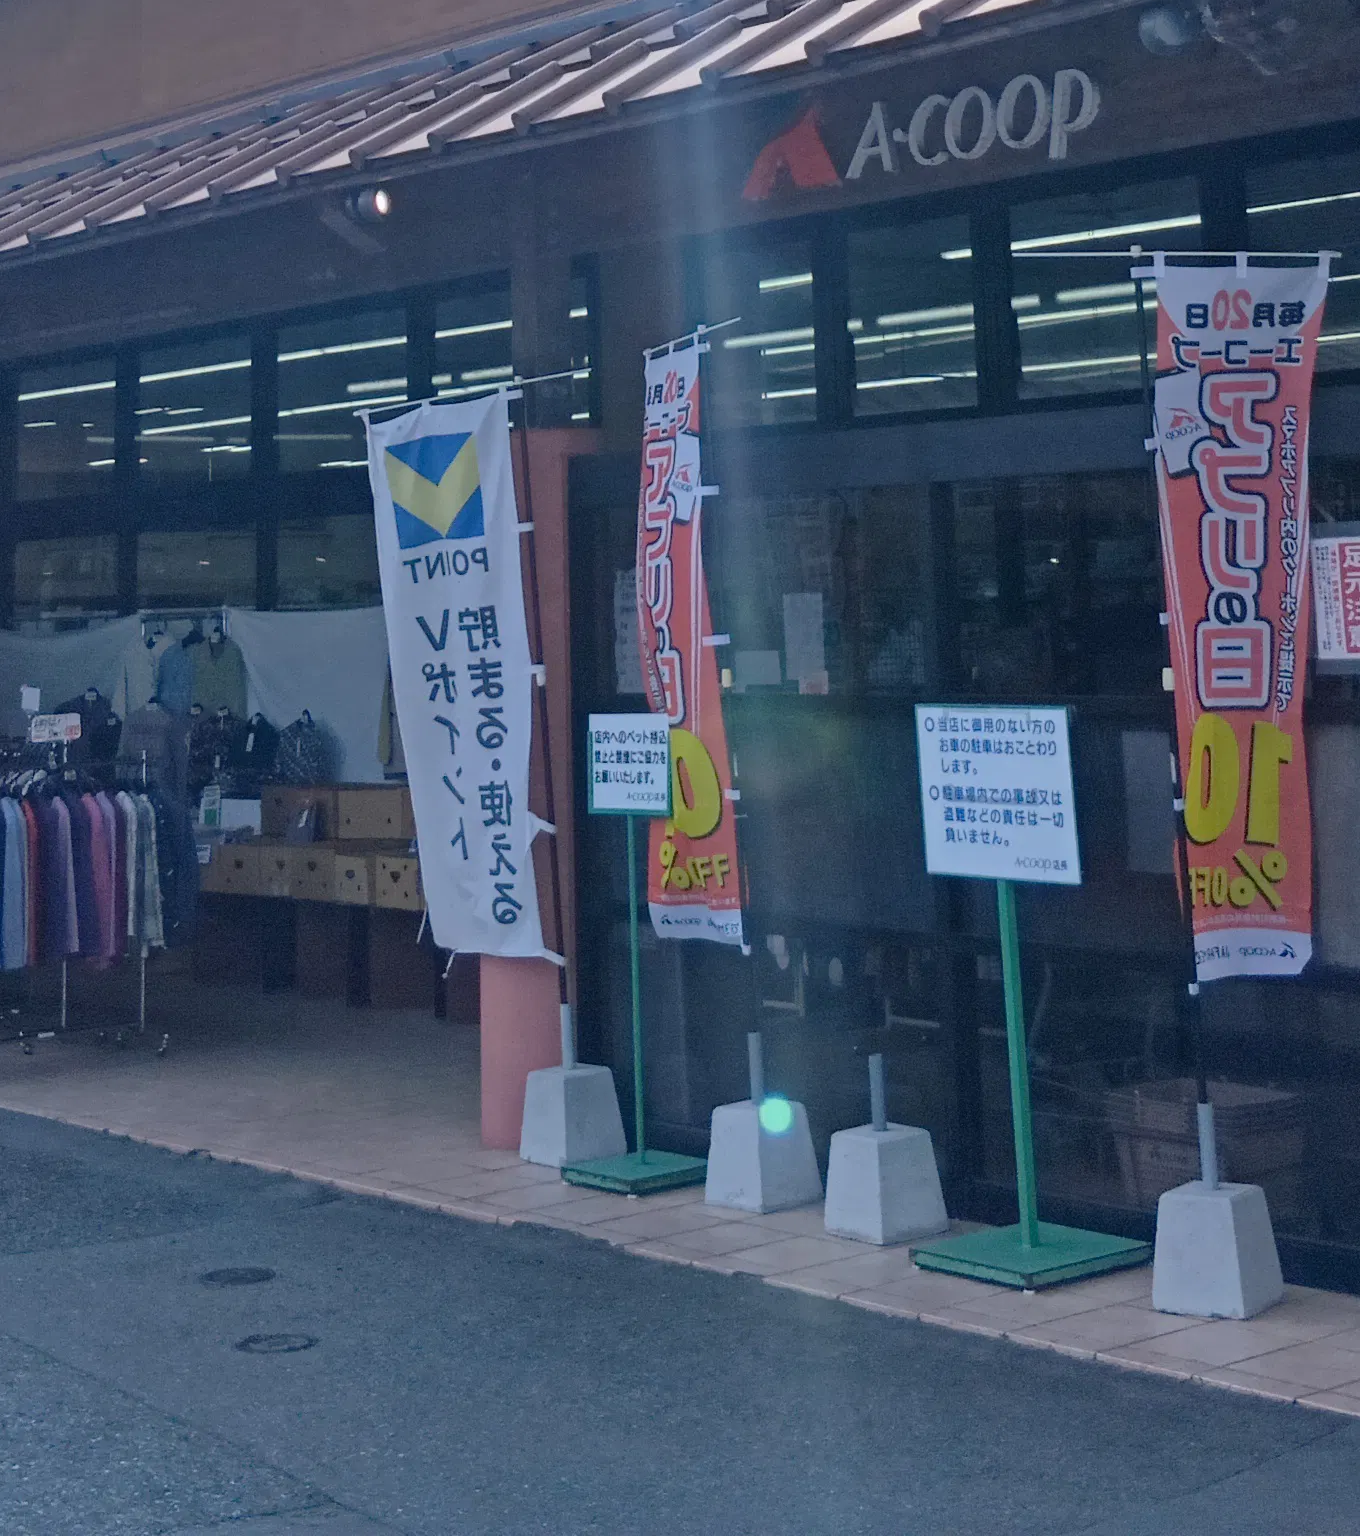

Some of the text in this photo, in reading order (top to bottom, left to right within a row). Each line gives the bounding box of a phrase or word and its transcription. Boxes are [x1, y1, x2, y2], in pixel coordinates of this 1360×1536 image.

[938, 717, 1056, 734] 当店に御用のない方の
[939, 738, 1057, 756] お車の駐車はおことわり
[940, 758, 978, 775] します。
[594, 770, 655, 785] お願いいたします。
[942, 785, 1063, 806] 駐車場内での事故又は
[943, 806, 1065, 828] 盗難などの責任は一切
[944, 827, 1010, 846] 負いません。
